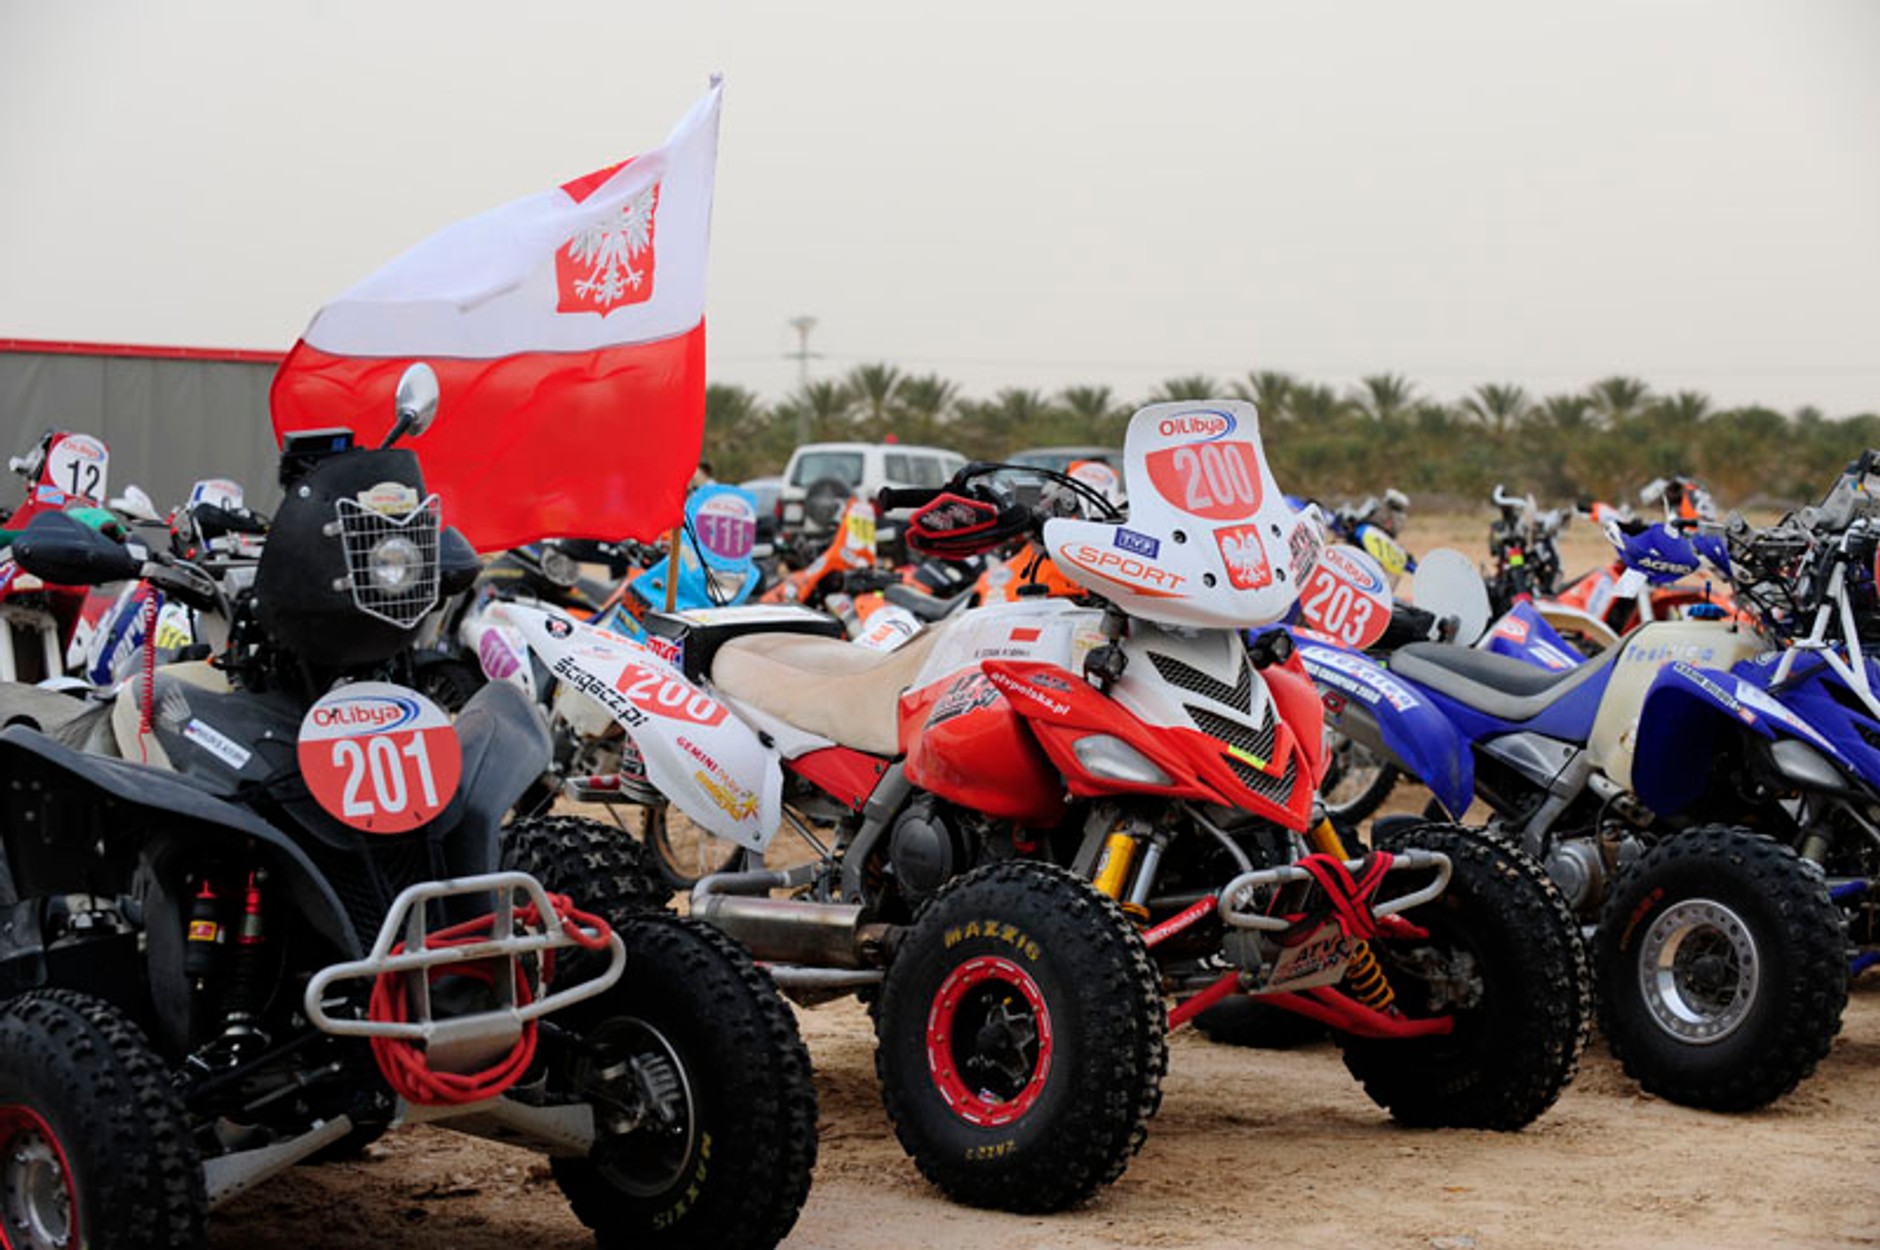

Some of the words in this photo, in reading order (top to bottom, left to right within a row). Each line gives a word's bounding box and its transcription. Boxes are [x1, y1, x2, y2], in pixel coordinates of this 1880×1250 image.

[1159, 417, 1227, 436] OiLibya
[67, 459, 100, 501] 12
[1173, 444, 1254, 511] 200
[704, 515, 745, 554] 111
[1077, 545, 1187, 590] SPORT
[1303, 573, 1374, 646] 203
[626, 665, 718, 721] 200
[312, 705, 401, 727] OiLibya
[331, 730, 439, 817] 201
[676, 735, 718, 773] GEMINI
